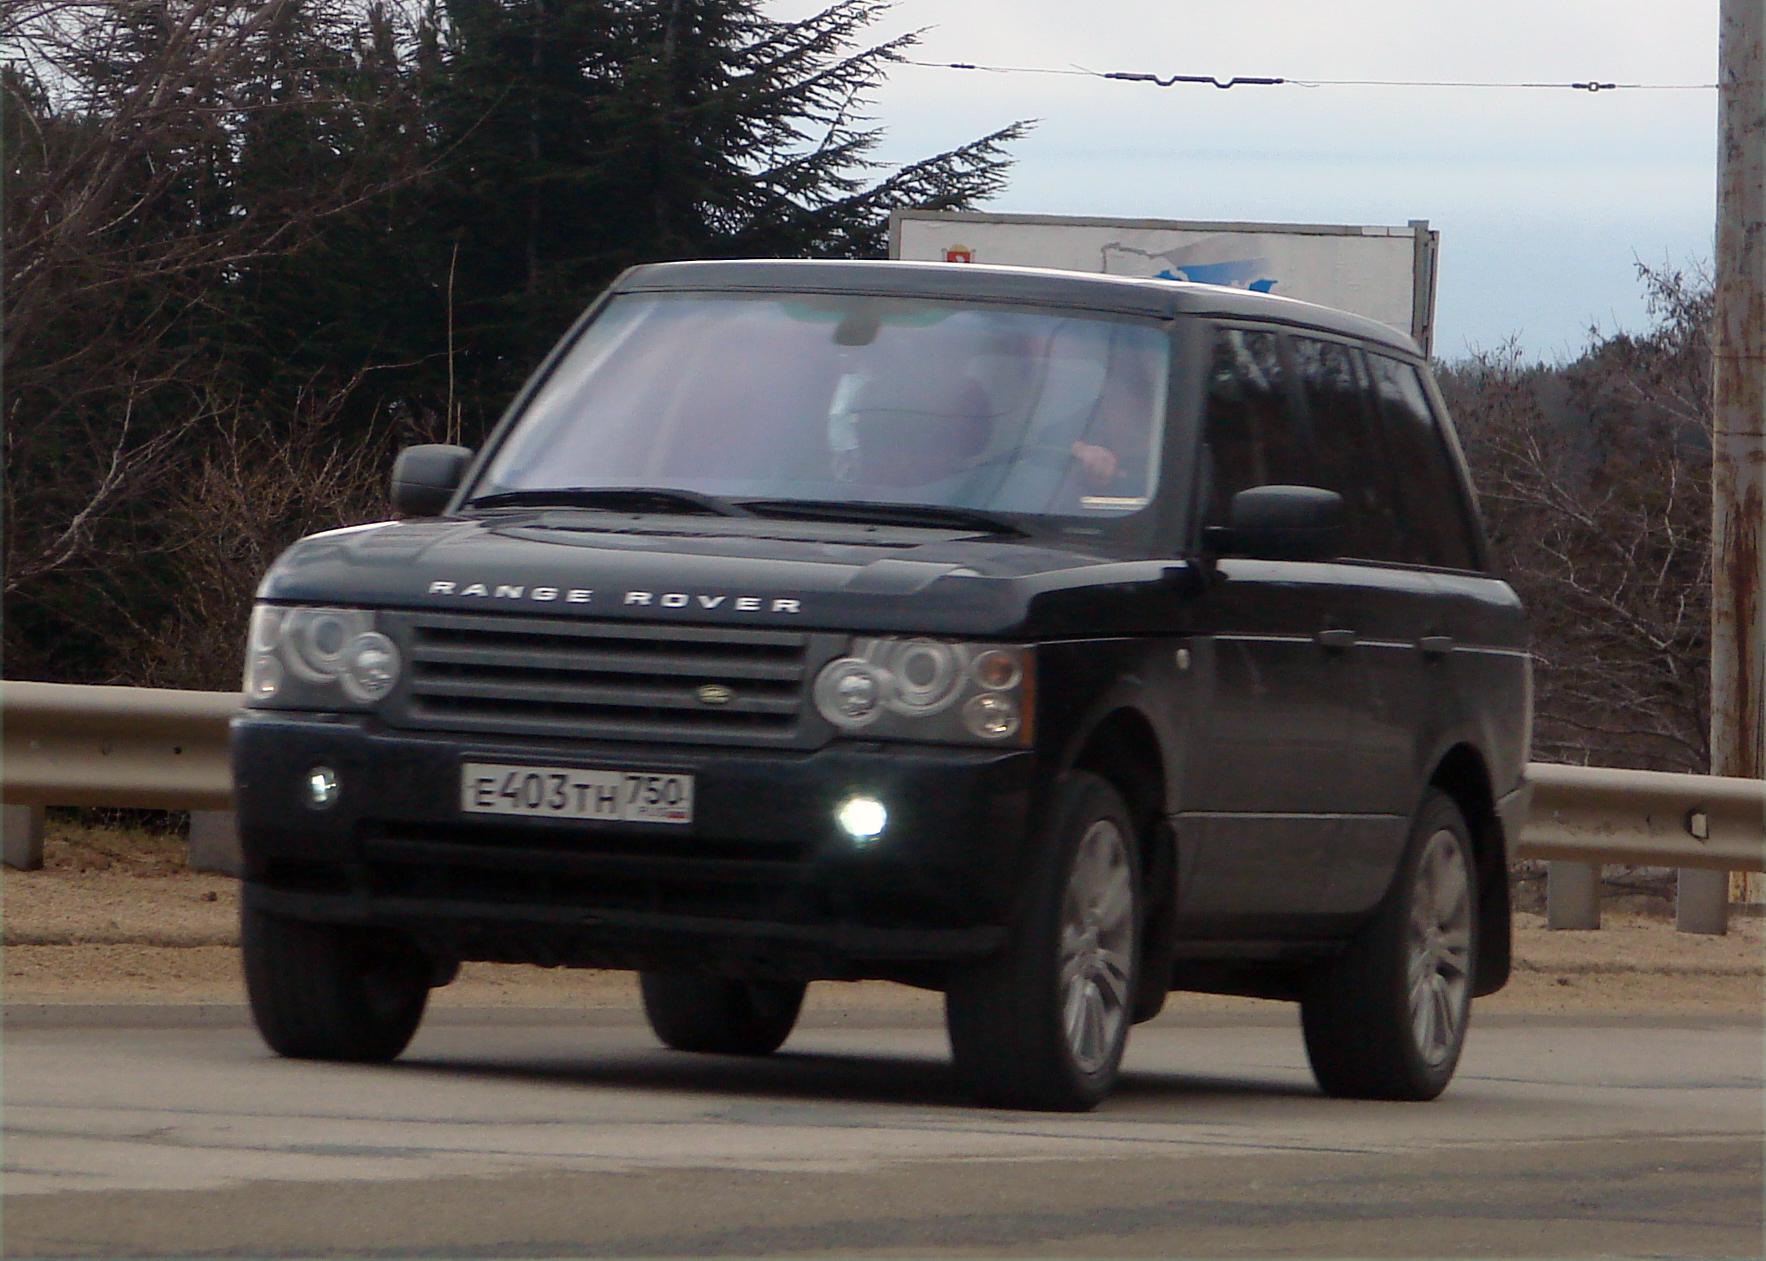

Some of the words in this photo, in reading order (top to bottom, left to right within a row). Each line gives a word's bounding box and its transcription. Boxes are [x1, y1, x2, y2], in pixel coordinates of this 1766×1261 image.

[428, 580, 593, 604] RANGE
[624, 590, 801, 614] ROVER
[625, 775, 684, 806] 750
